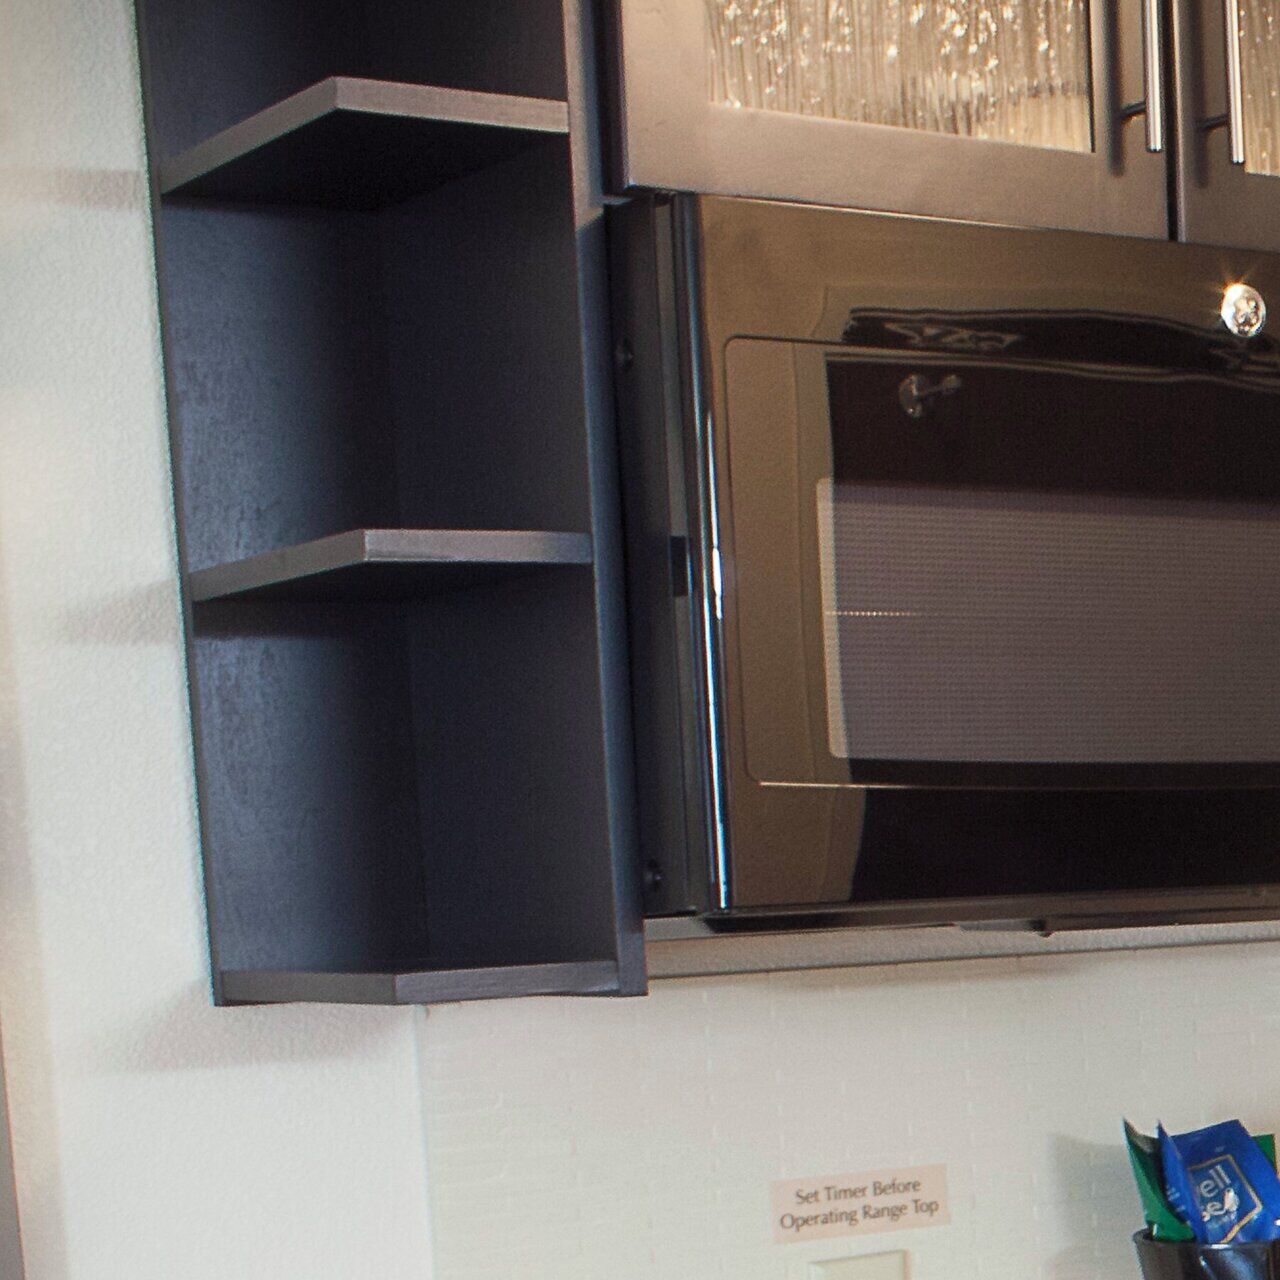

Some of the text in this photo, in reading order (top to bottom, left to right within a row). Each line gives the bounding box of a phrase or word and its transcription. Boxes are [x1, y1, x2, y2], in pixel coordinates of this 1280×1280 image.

[795, 1178, 922, 1205] Set Timer Before
[780, 1198, 940, 1232] Operating Range Top
